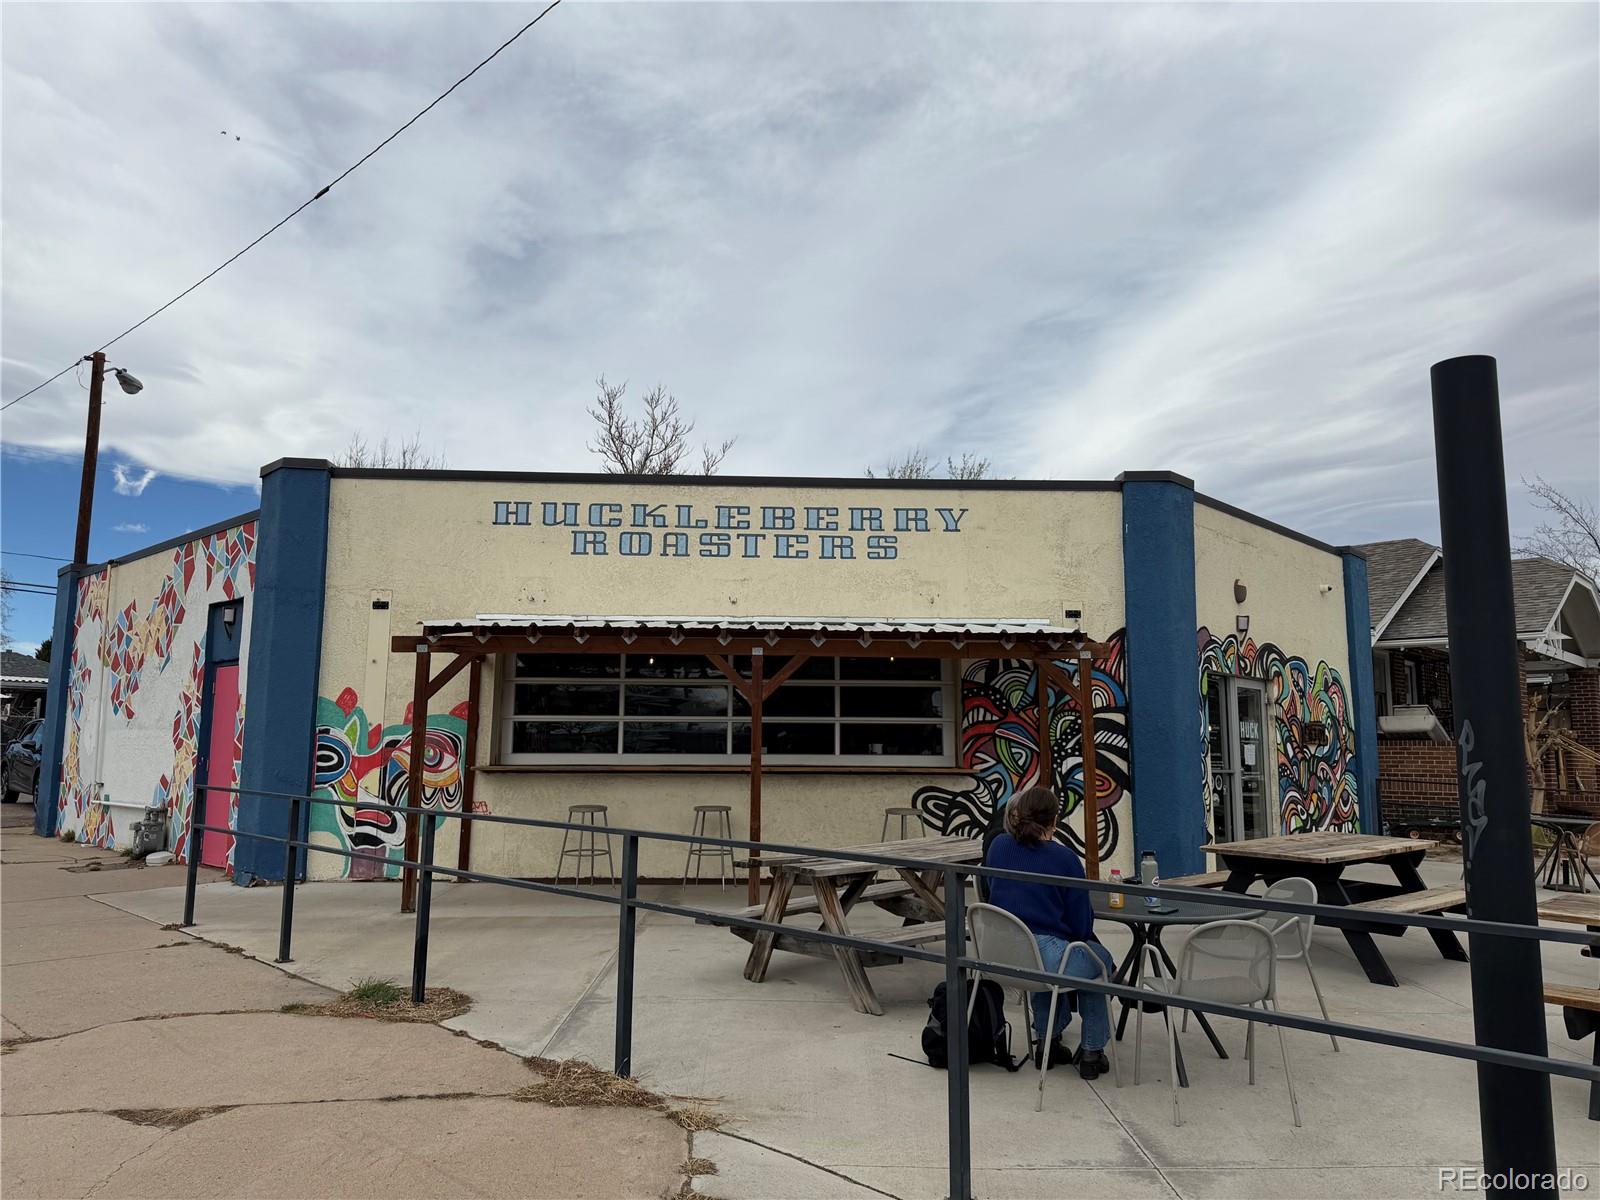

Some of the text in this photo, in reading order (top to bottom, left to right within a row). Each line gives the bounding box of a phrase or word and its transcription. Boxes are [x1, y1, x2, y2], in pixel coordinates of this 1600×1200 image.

[493, 501, 968, 532] HUCKLEBERRY
[570, 530, 899, 560] ROASTERS
[1240, 721, 1259, 739] HUCK
